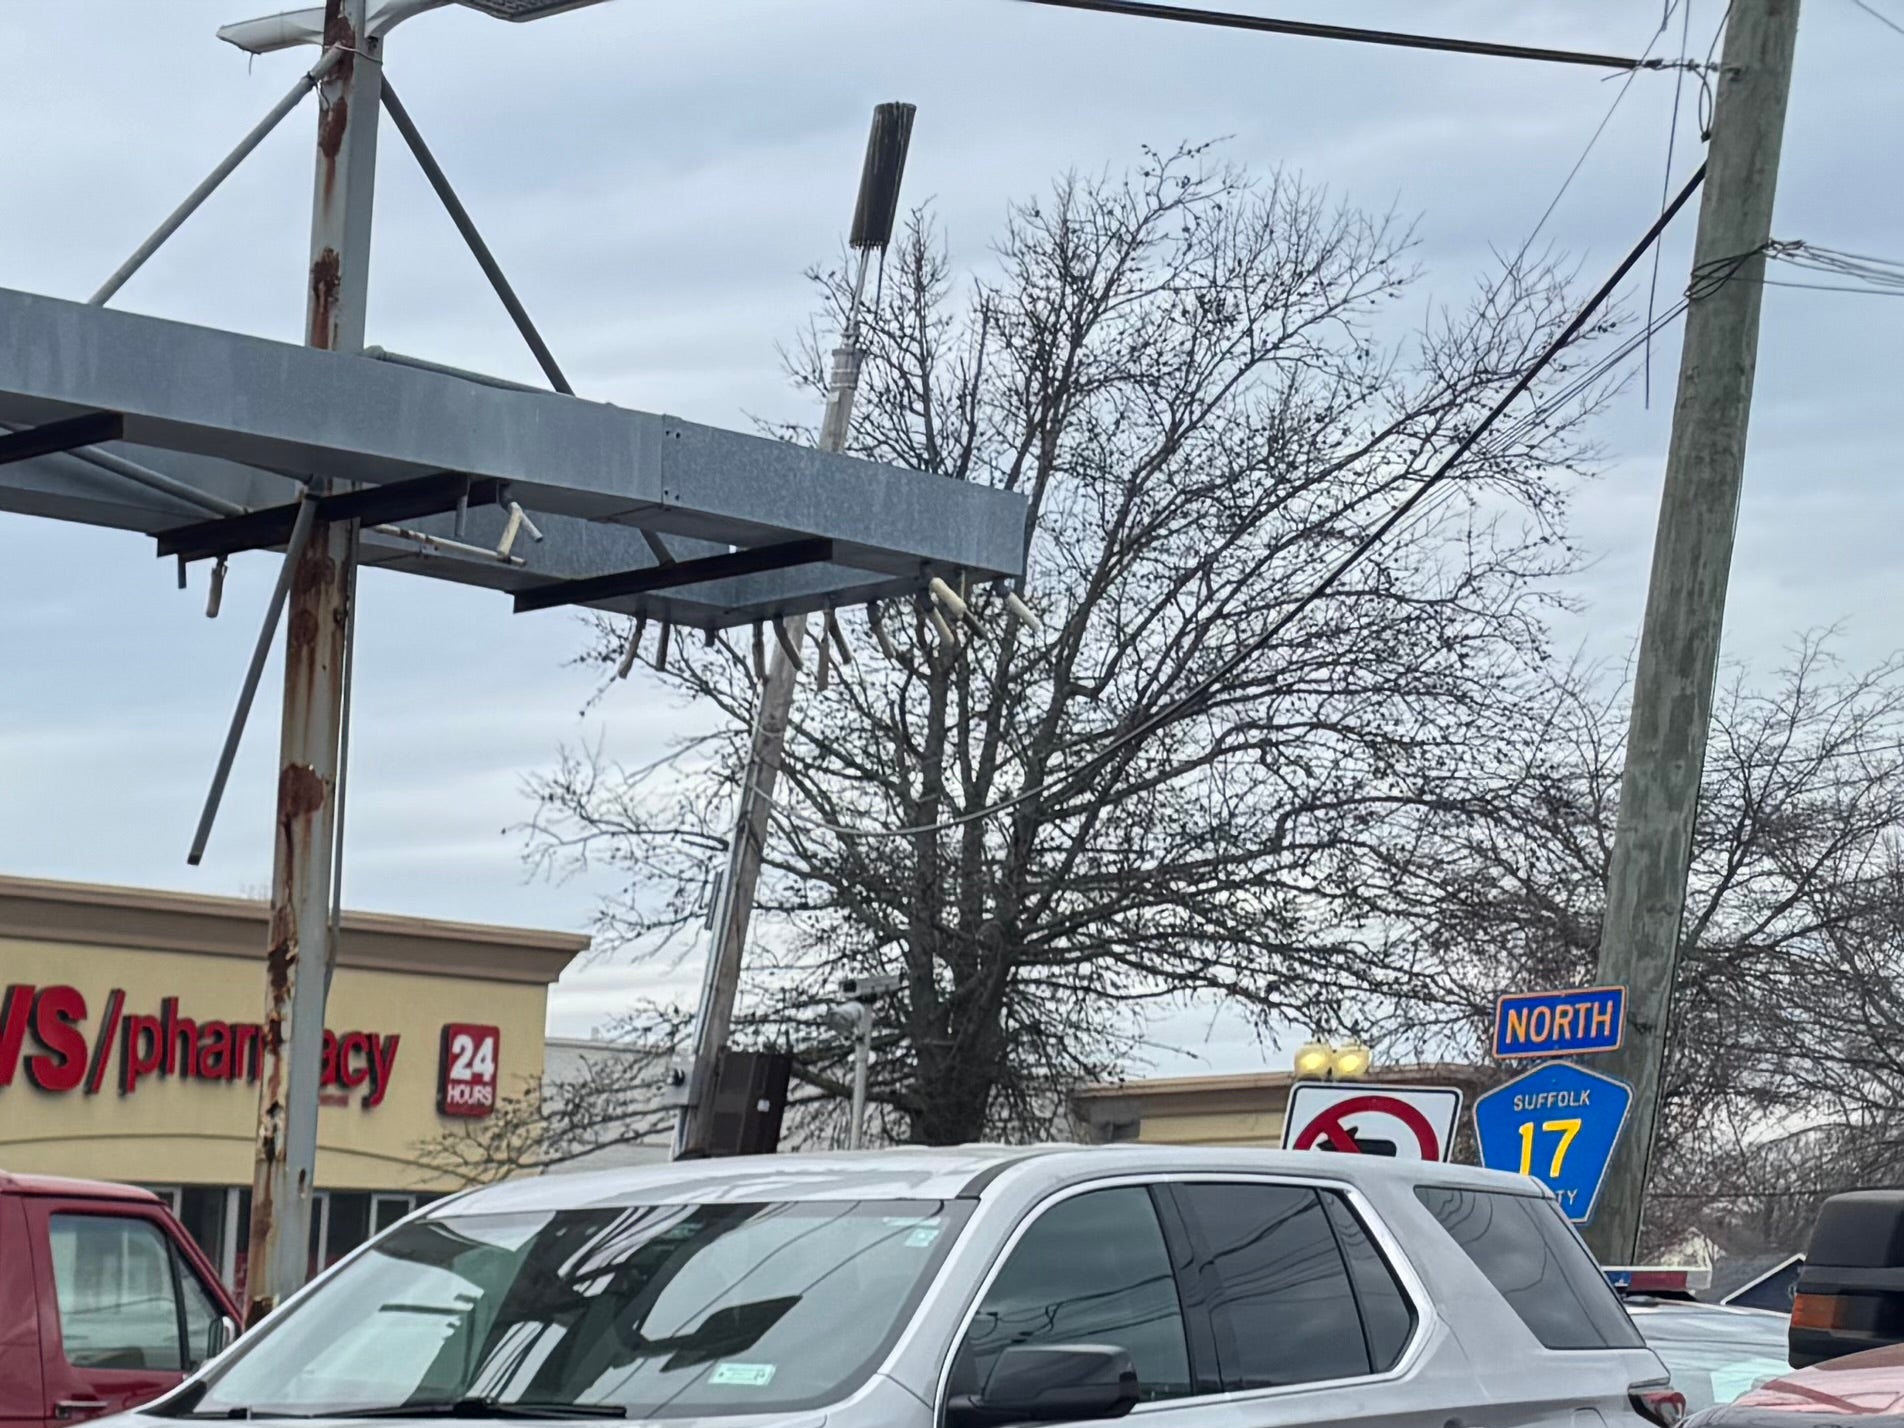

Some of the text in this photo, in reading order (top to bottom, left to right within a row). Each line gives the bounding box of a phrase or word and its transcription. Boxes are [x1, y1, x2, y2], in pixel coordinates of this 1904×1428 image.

[1505, 1000, 1614, 1045] NORTH
[450, 1033, 496, 1083] 24
[447, 1083, 494, 1107] HOURS
[1513, 1089, 1591, 1112] SUFFOLK
[1518, 1118, 1583, 1179] 17
